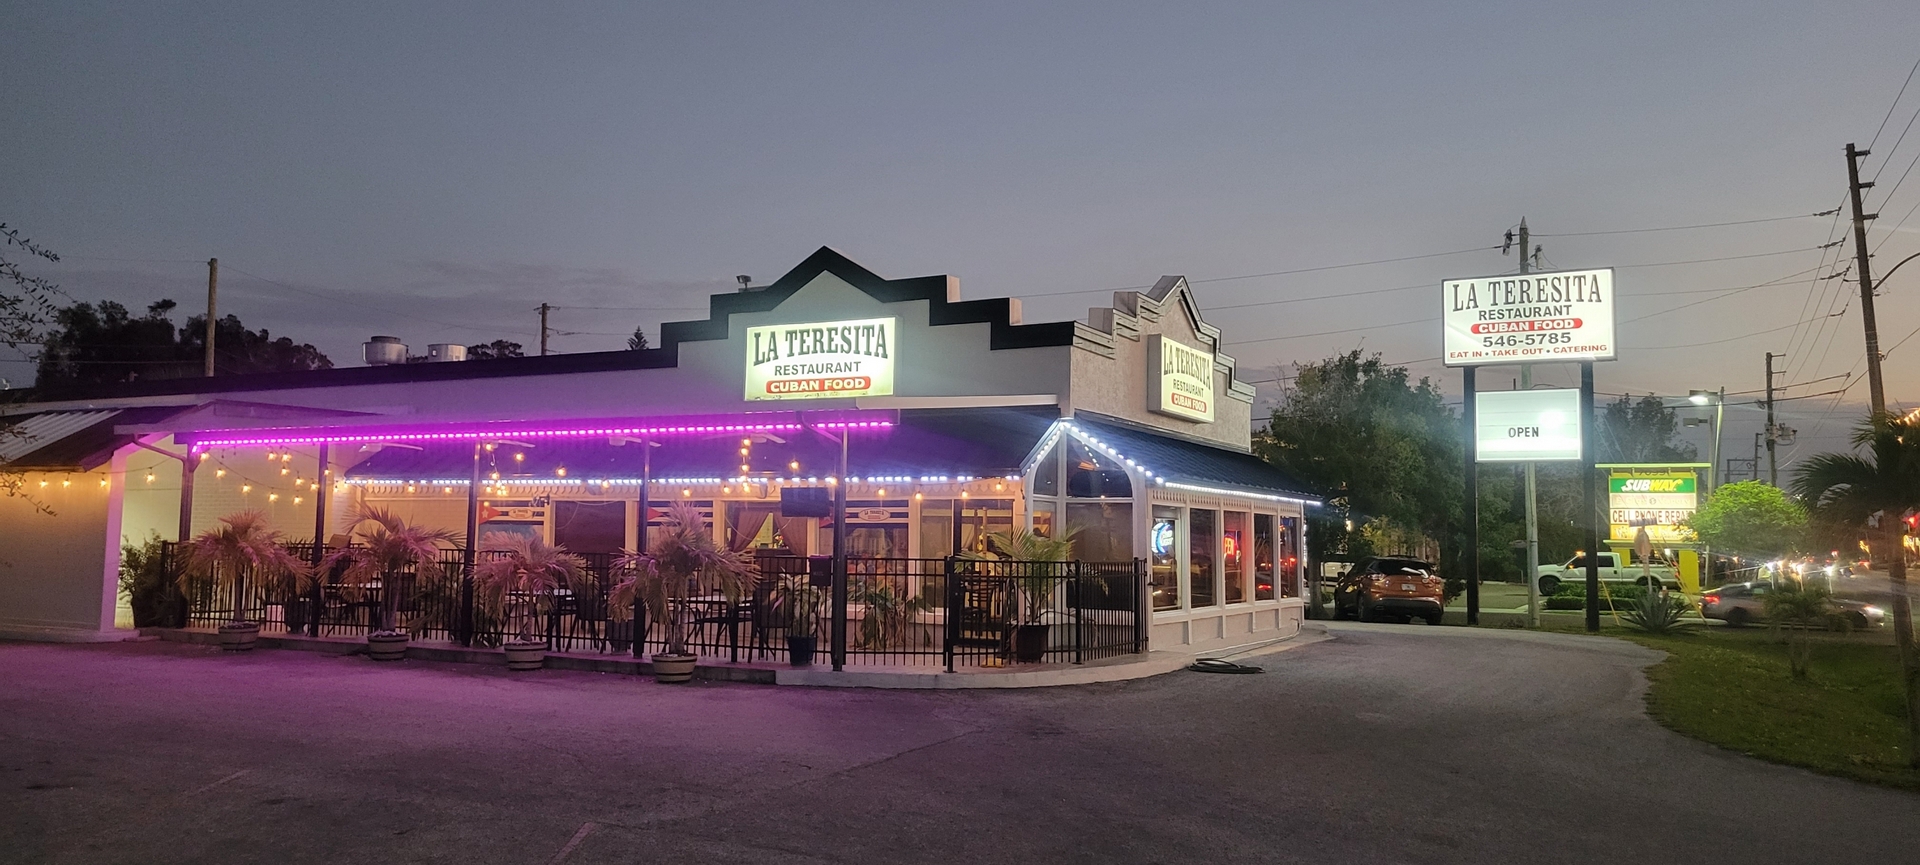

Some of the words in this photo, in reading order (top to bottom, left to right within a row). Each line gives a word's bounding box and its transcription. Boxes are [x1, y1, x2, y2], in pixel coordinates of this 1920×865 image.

[1453, 282, 1479, 312] LA
[1487, 274, 1602, 306] TERESITA
[1478, 304, 1572, 321] RESTAURANT
[1478, 320, 1529, 333] CUBAN
[1534, 319, 1574, 331] FOOD
[753, 330, 779, 366] LA
[785, 324, 888, 359] TERESITA
[1483, 332, 1572, 348] 546-5785
[1450, 351, 1469, 359] EAT
[1492, 349, 1518, 357] TAKE
[1553, 344, 1607, 354] CATERING
[774, 361, 862, 376] RESTAURANT
[1163, 342, 1174, 376] LA
[1175, 346, 1211, 391] TERESITA
[770, 380, 820, 392] CUBAN
[824, 378, 866, 390] FOOD
[1172, 378, 1204, 398] RESTAURANT
[1174, 394, 1191, 408] CUBAN
[1193, 399, 1205, 412] FOOD
[1508, 426, 1540, 438] OPEN
[1621, 479, 1683, 492] SUBWAY
[1612, 510, 1630, 523] CELL
[1665, 510, 1691, 523] REPA
